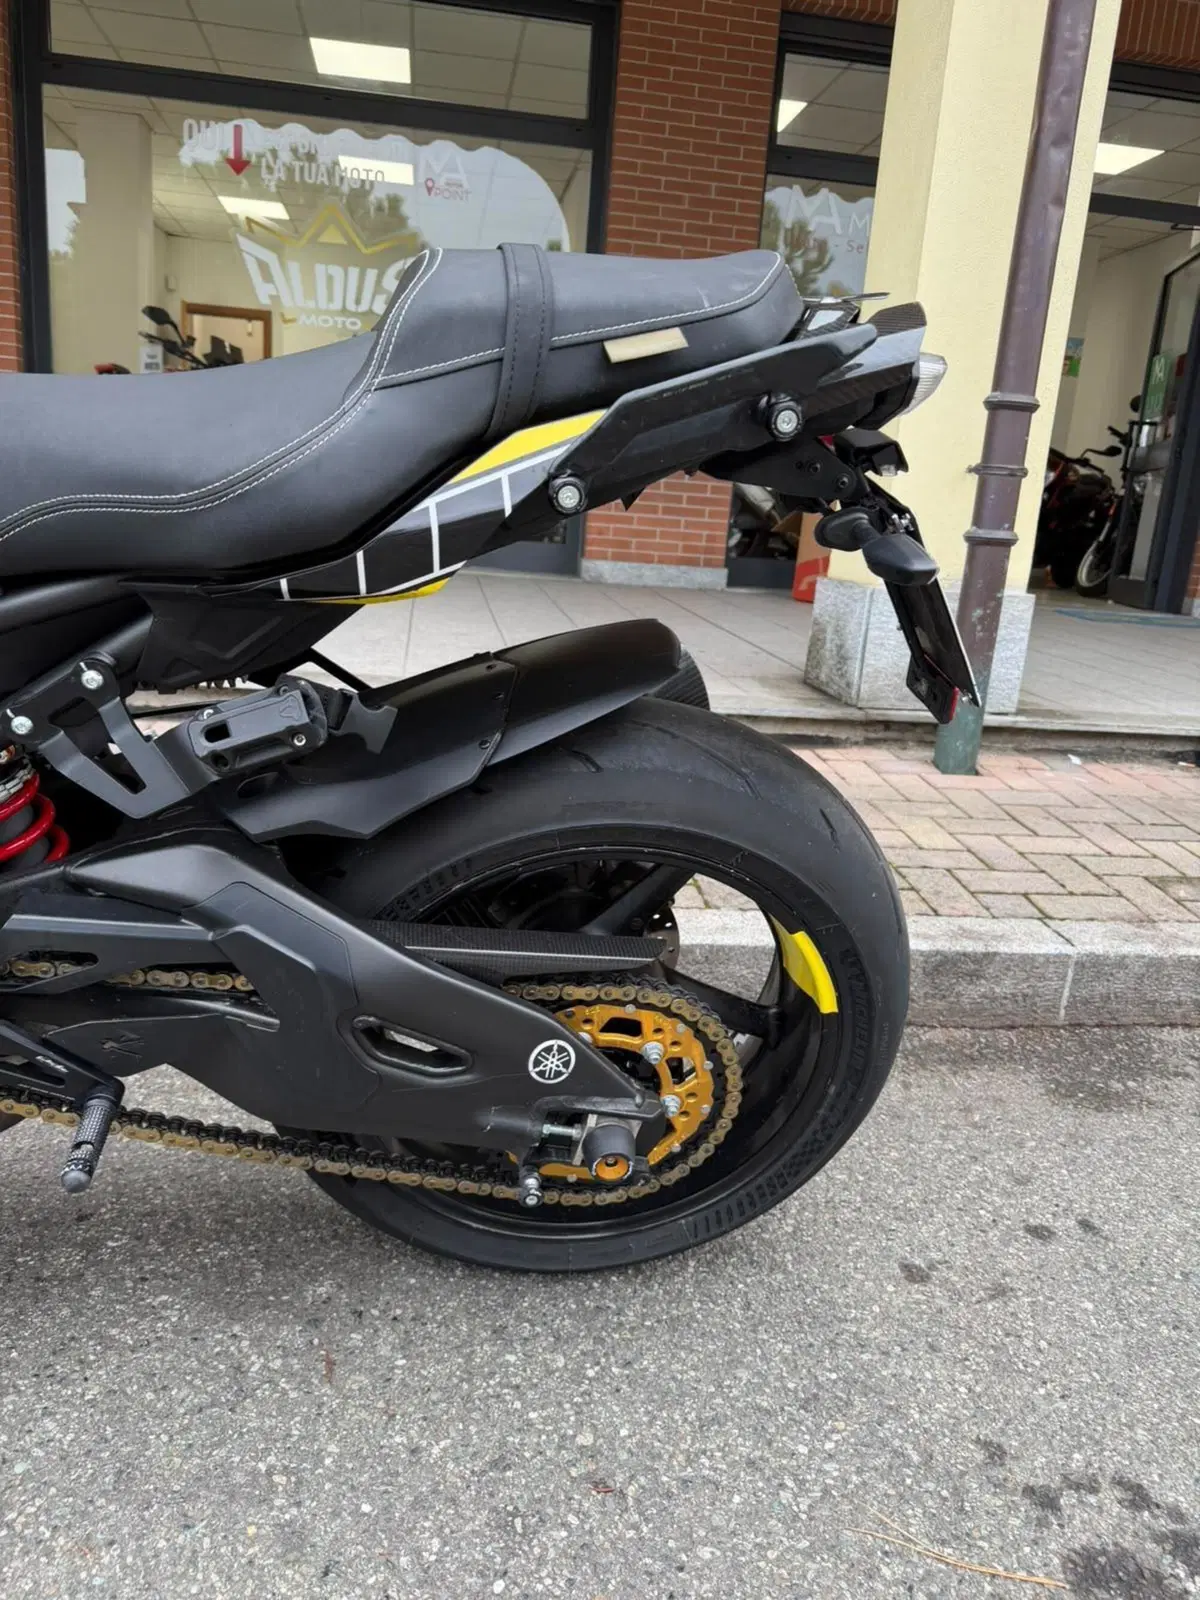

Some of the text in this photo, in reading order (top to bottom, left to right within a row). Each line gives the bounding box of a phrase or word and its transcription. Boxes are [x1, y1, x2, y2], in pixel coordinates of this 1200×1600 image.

[261, 157, 385, 191] LA TUA MOTO
[236, 233, 417, 315] ALDUS
[300, 314, 362, 330] MOTO
